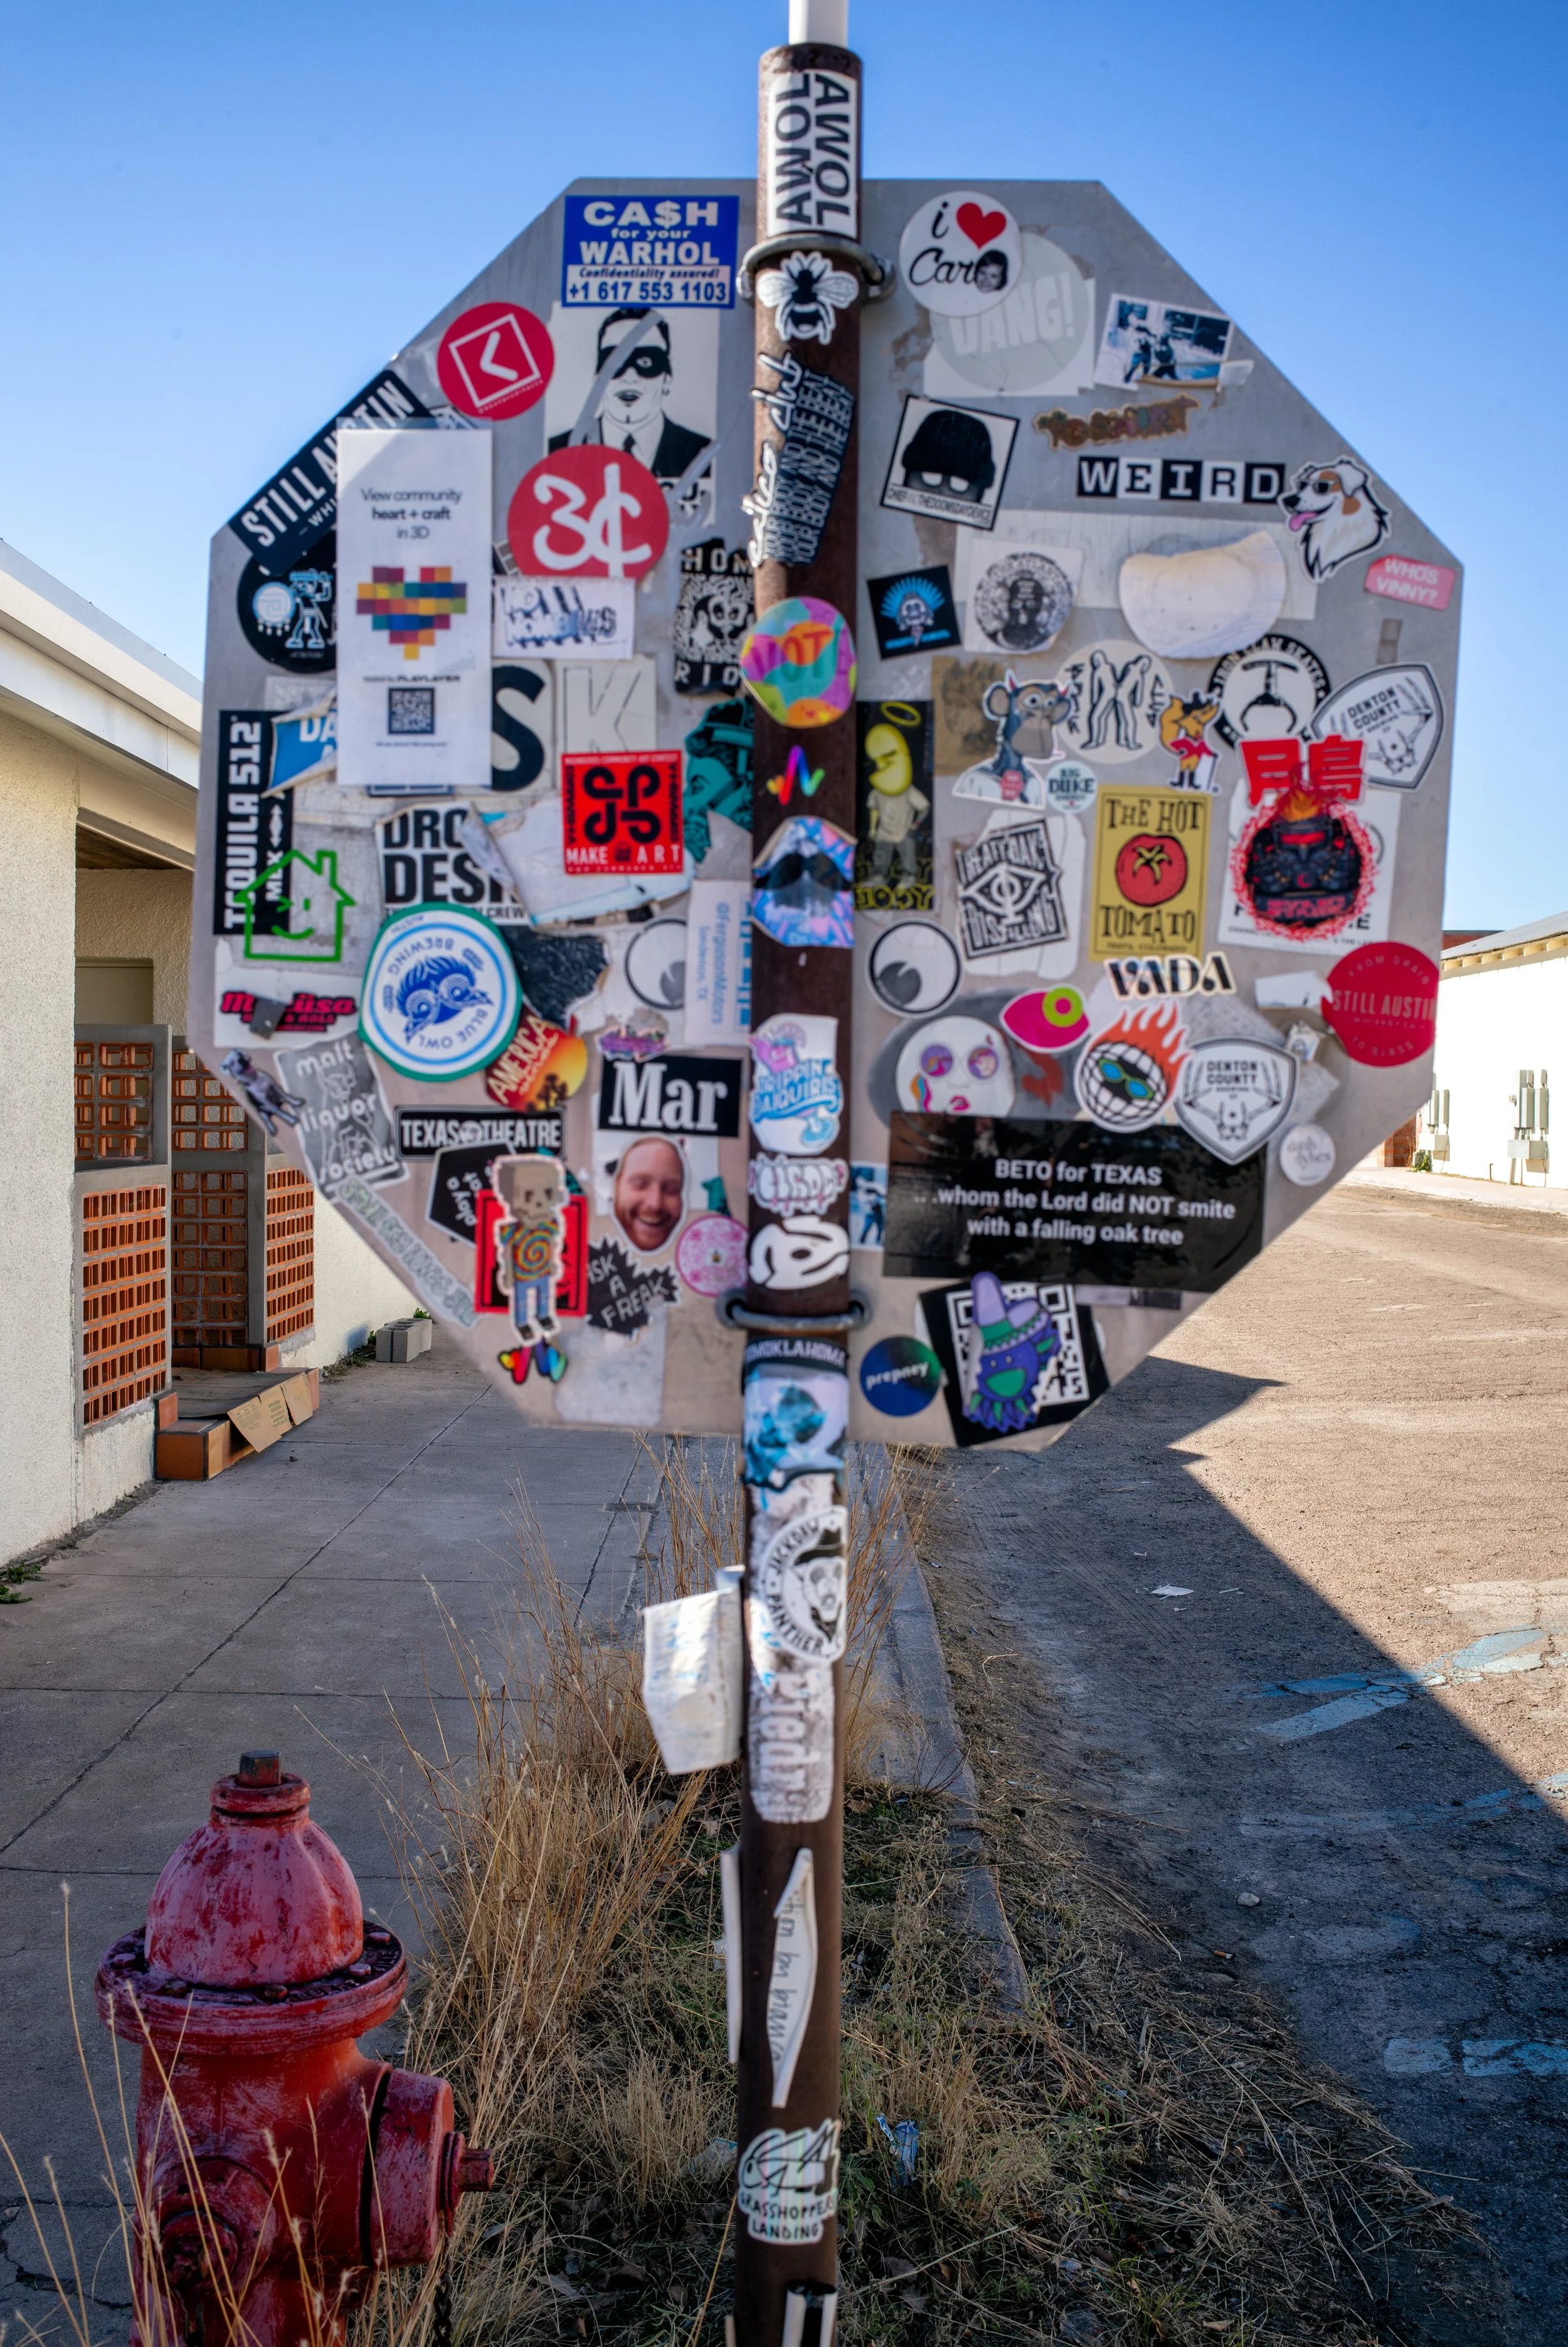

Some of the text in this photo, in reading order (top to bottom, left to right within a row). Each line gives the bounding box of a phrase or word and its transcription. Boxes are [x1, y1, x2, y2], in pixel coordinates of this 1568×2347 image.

[776, 73, 811, 225] AWOL
[815, 73, 849, 225] AWOL
[611, 229, 691, 241] for your
[580, 242, 719, 265] WARHOL
[580, 268, 719, 281] Confidentiality assured!
[569, 282, 726, 301] +1 617 553 1103
[751, 351, 802, 432] club
[1080, 459, 1282, 500] WEIRD
[241, 466, 327, 547] STILL
[361, 488, 462, 507] View community
[372, 507, 406, 521] heart
[423, 507, 452, 521] craft
[397, 526, 430, 539] in 3D
[1384, 558, 1439, 585] WHO'S
[1375, 576, 1439, 605] VINNY?
[1347, 687, 1397, 719] DENTON
[1352, 699, 1401, 730] COUNTY
[230, 721, 261, 785] 512
[1049, 778, 1094, 793] DUKE
[1106, 797, 1204, 833] THE HOT
[566, 844, 680, 865] MAKE ART
[1101, 904, 1195, 945] TOMATO
[387, 937, 455, 975] BREWING
[1108, 955, 1232, 997] VADA
[1333, 989, 1375, 1015] STILL
[418, 1007, 489, 1050] BLUE OWL
[296, 1039, 354, 1077] malt
[487, 1015, 553, 1104] AMERICA
[1207, 1060, 1258, 1072] DENTON
[1207, 1074, 1258, 1084] COUNTY
[608, 1061, 729, 1131] Mar
[300, 1093, 378, 1132] liquor
[401, 1119, 561, 1147] TEXAS THEATRE
[320, 1144, 396, 1184] society
[995, 1159, 1162, 1186] BETO for TEXAS
[1004, 1189, 1037, 1209] the
[1041, 1190, 1088, 1212] Lord
[1092, 1193, 1125, 1214] did
[1130, 1195, 1174, 1216] NOT
[1177, 1197, 1236, 1220] smite
[967, 1215, 1184, 1245] with a falling oak tree
[609, 1274, 627, 1298] A
[601, 1276, 669, 1328] FREAK
[766, 1594, 824, 1655] PANTHER
[753, 2219, 819, 2239] LANDING
